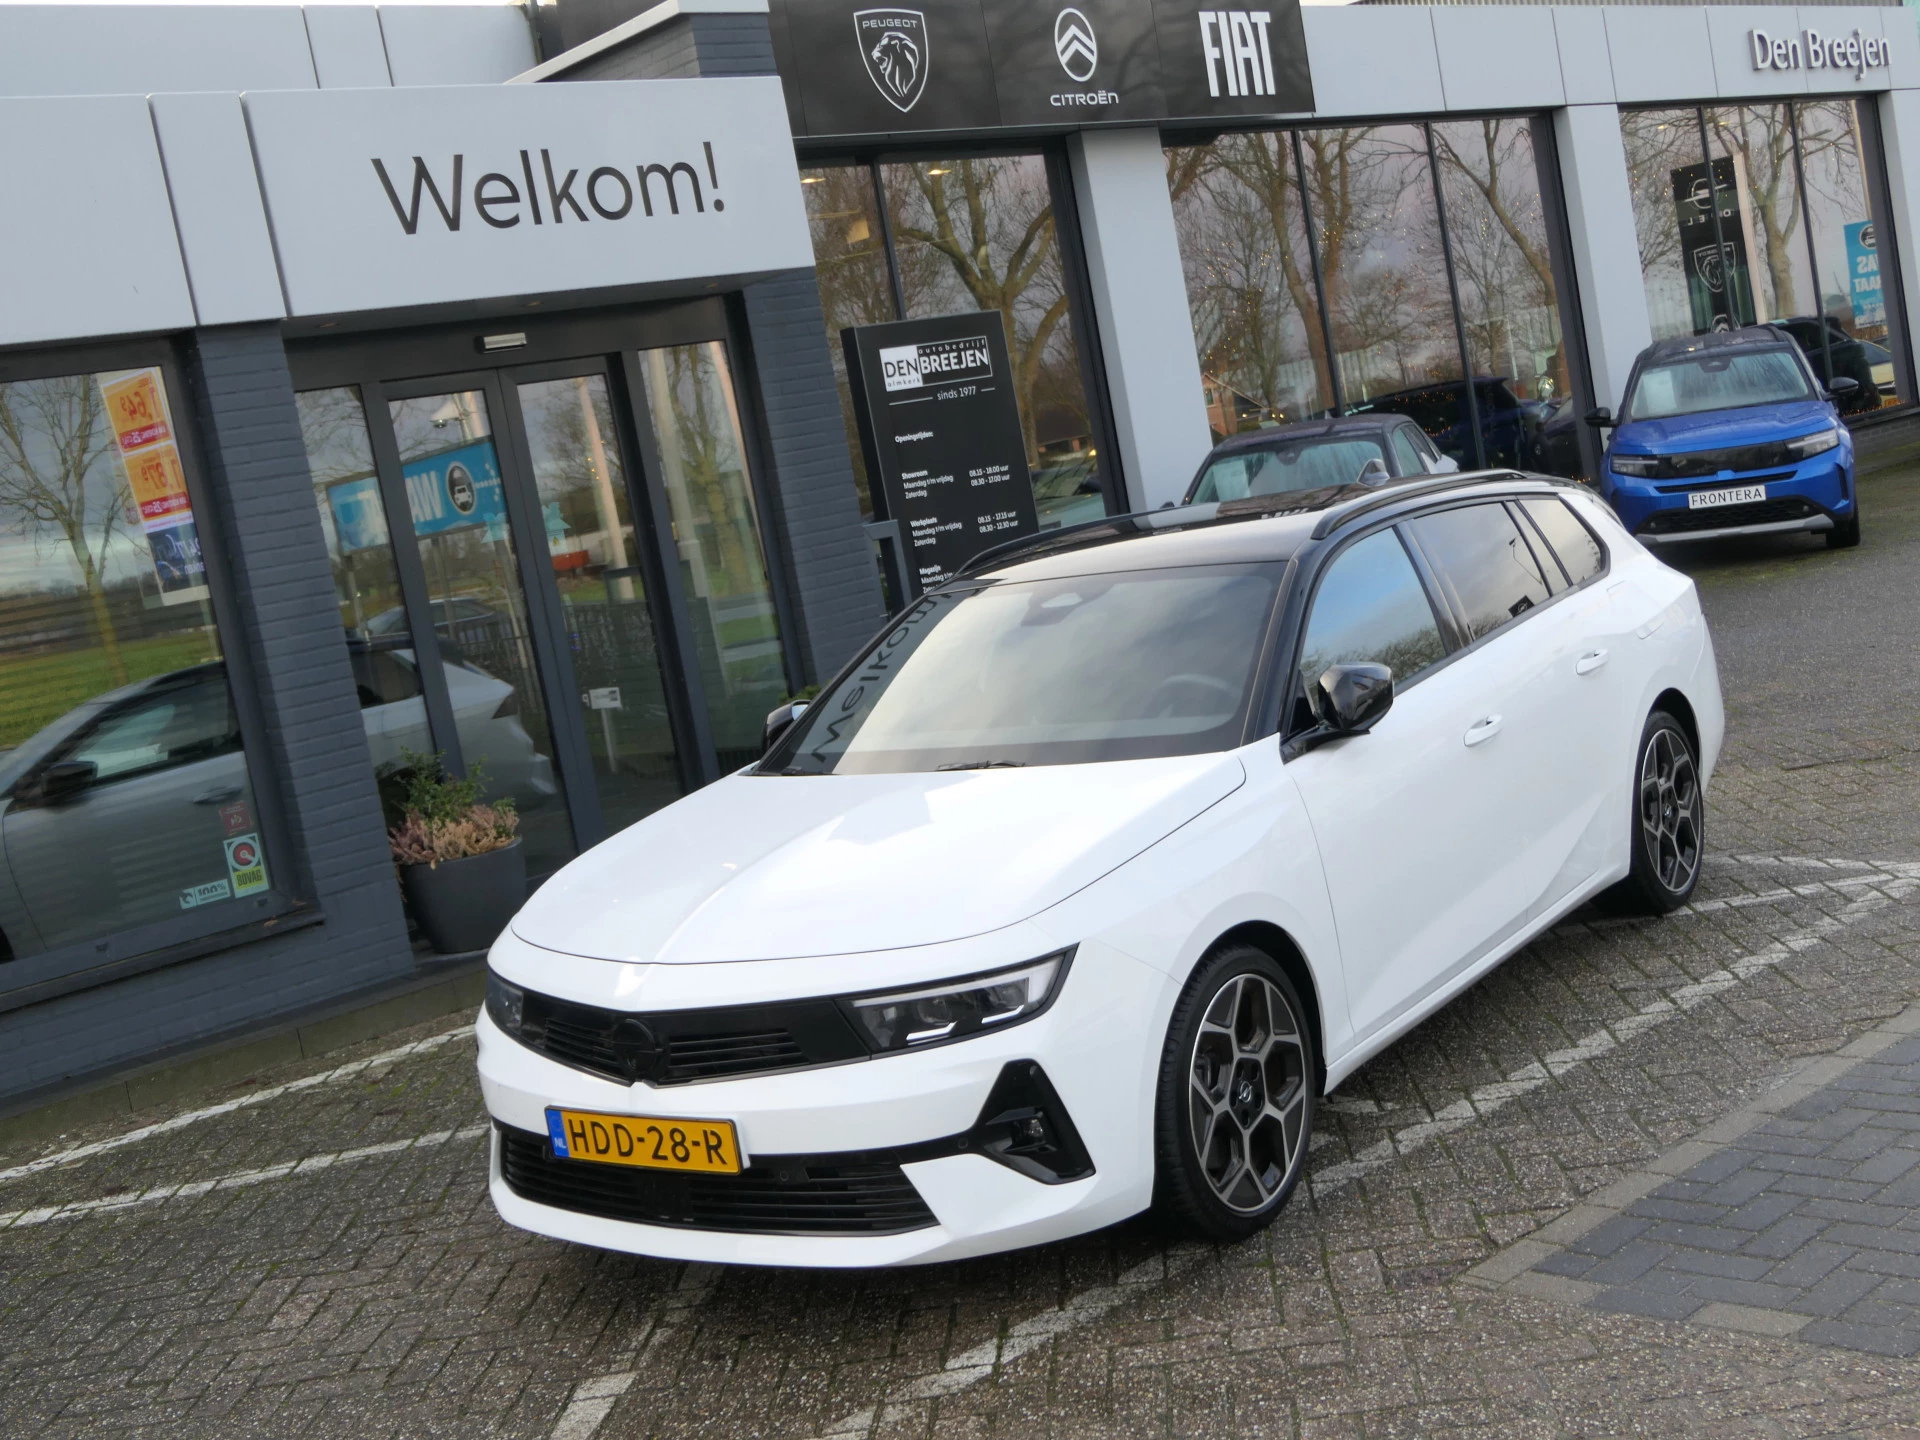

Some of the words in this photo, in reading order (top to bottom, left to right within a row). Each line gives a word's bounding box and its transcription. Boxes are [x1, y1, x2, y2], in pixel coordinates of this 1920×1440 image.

[862, 18, 918, 29] PEUGEOT
[1198, 11, 1276, 97] FIAT
[1748, 29, 1802, 71] Den
[1802, 28, 1892, 81] Breejen
[370, 141, 725, 235] Welkom!
[918, 338, 986, 355] autobedrijf
[884, 358, 919, 378] DEN
[919, 348, 989, 375] BREEJEN
[887, 378, 921, 388] almkerk
[937, 389, 958, 401] sinds
[959, 386, 977, 398] 1977
[902, 470, 928, 480] Showroom
[1000, 474, 1010, 482] uur
[903, 481, 927, 490] Maandag
[936, 475, 954, 484] vrijdag
[905, 489, 928, 500] Zaterdag
[1691, 487, 1763, 507] FRONTERA
[1007, 510, 1017, 518] uur
[910, 517, 937, 528] Werkplaats
[1010, 519, 1019, 527] uur
[912, 527, 935, 538] Maandag
[945, 521, 962, 531] vrijdag
[914, 537, 936, 547] Zaterdag
[919, 564, 941, 575] Magazijn
[921, 574, 944, 584] Maandag
[236, 869, 263, 887] BOVAG
[554, 1137, 567, 1149] NL
[568, 1118, 728, 1165] HDD-28-R
